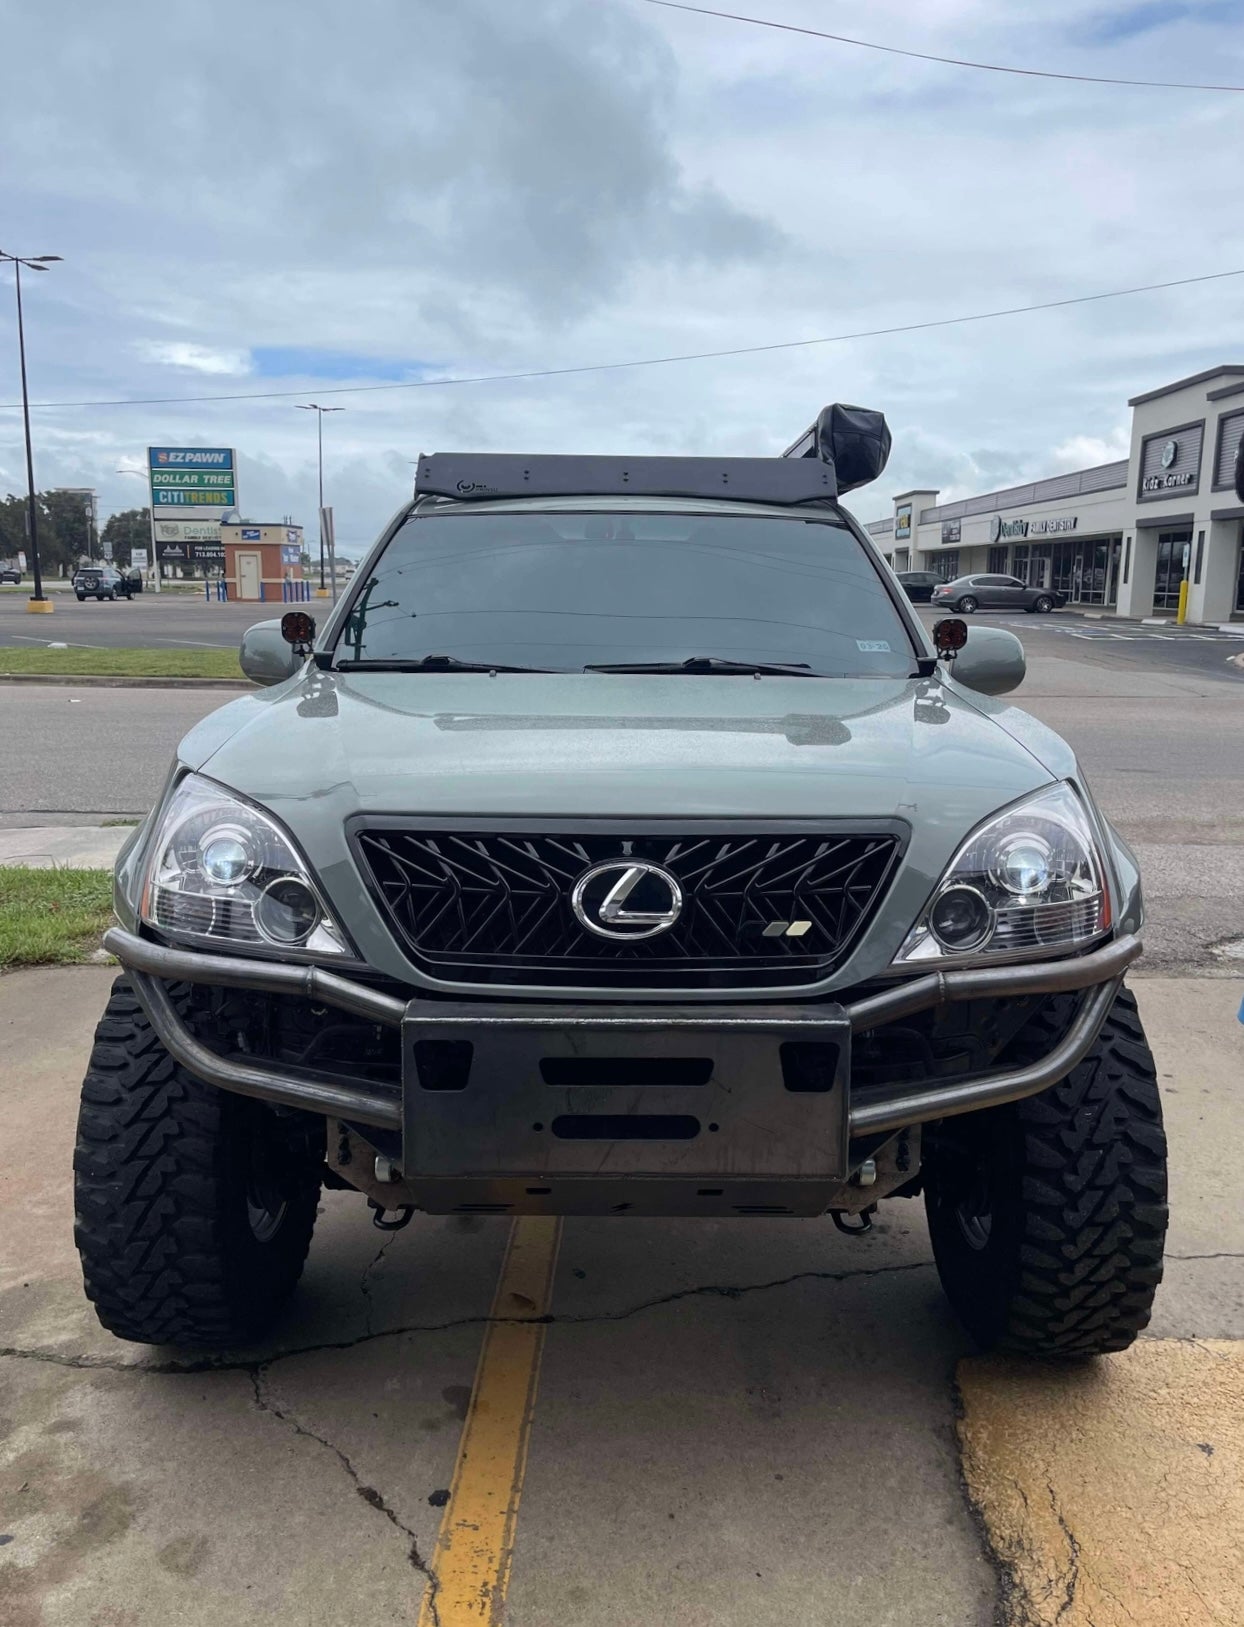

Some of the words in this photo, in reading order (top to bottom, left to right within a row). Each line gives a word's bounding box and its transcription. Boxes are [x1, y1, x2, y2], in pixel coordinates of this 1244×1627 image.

[153, 474, 199, 483] DOLLAR
[203, 475, 232, 484] TREE
[1142, 476, 1160, 491] Kidz
[1163, 473, 1190, 487] Korner
